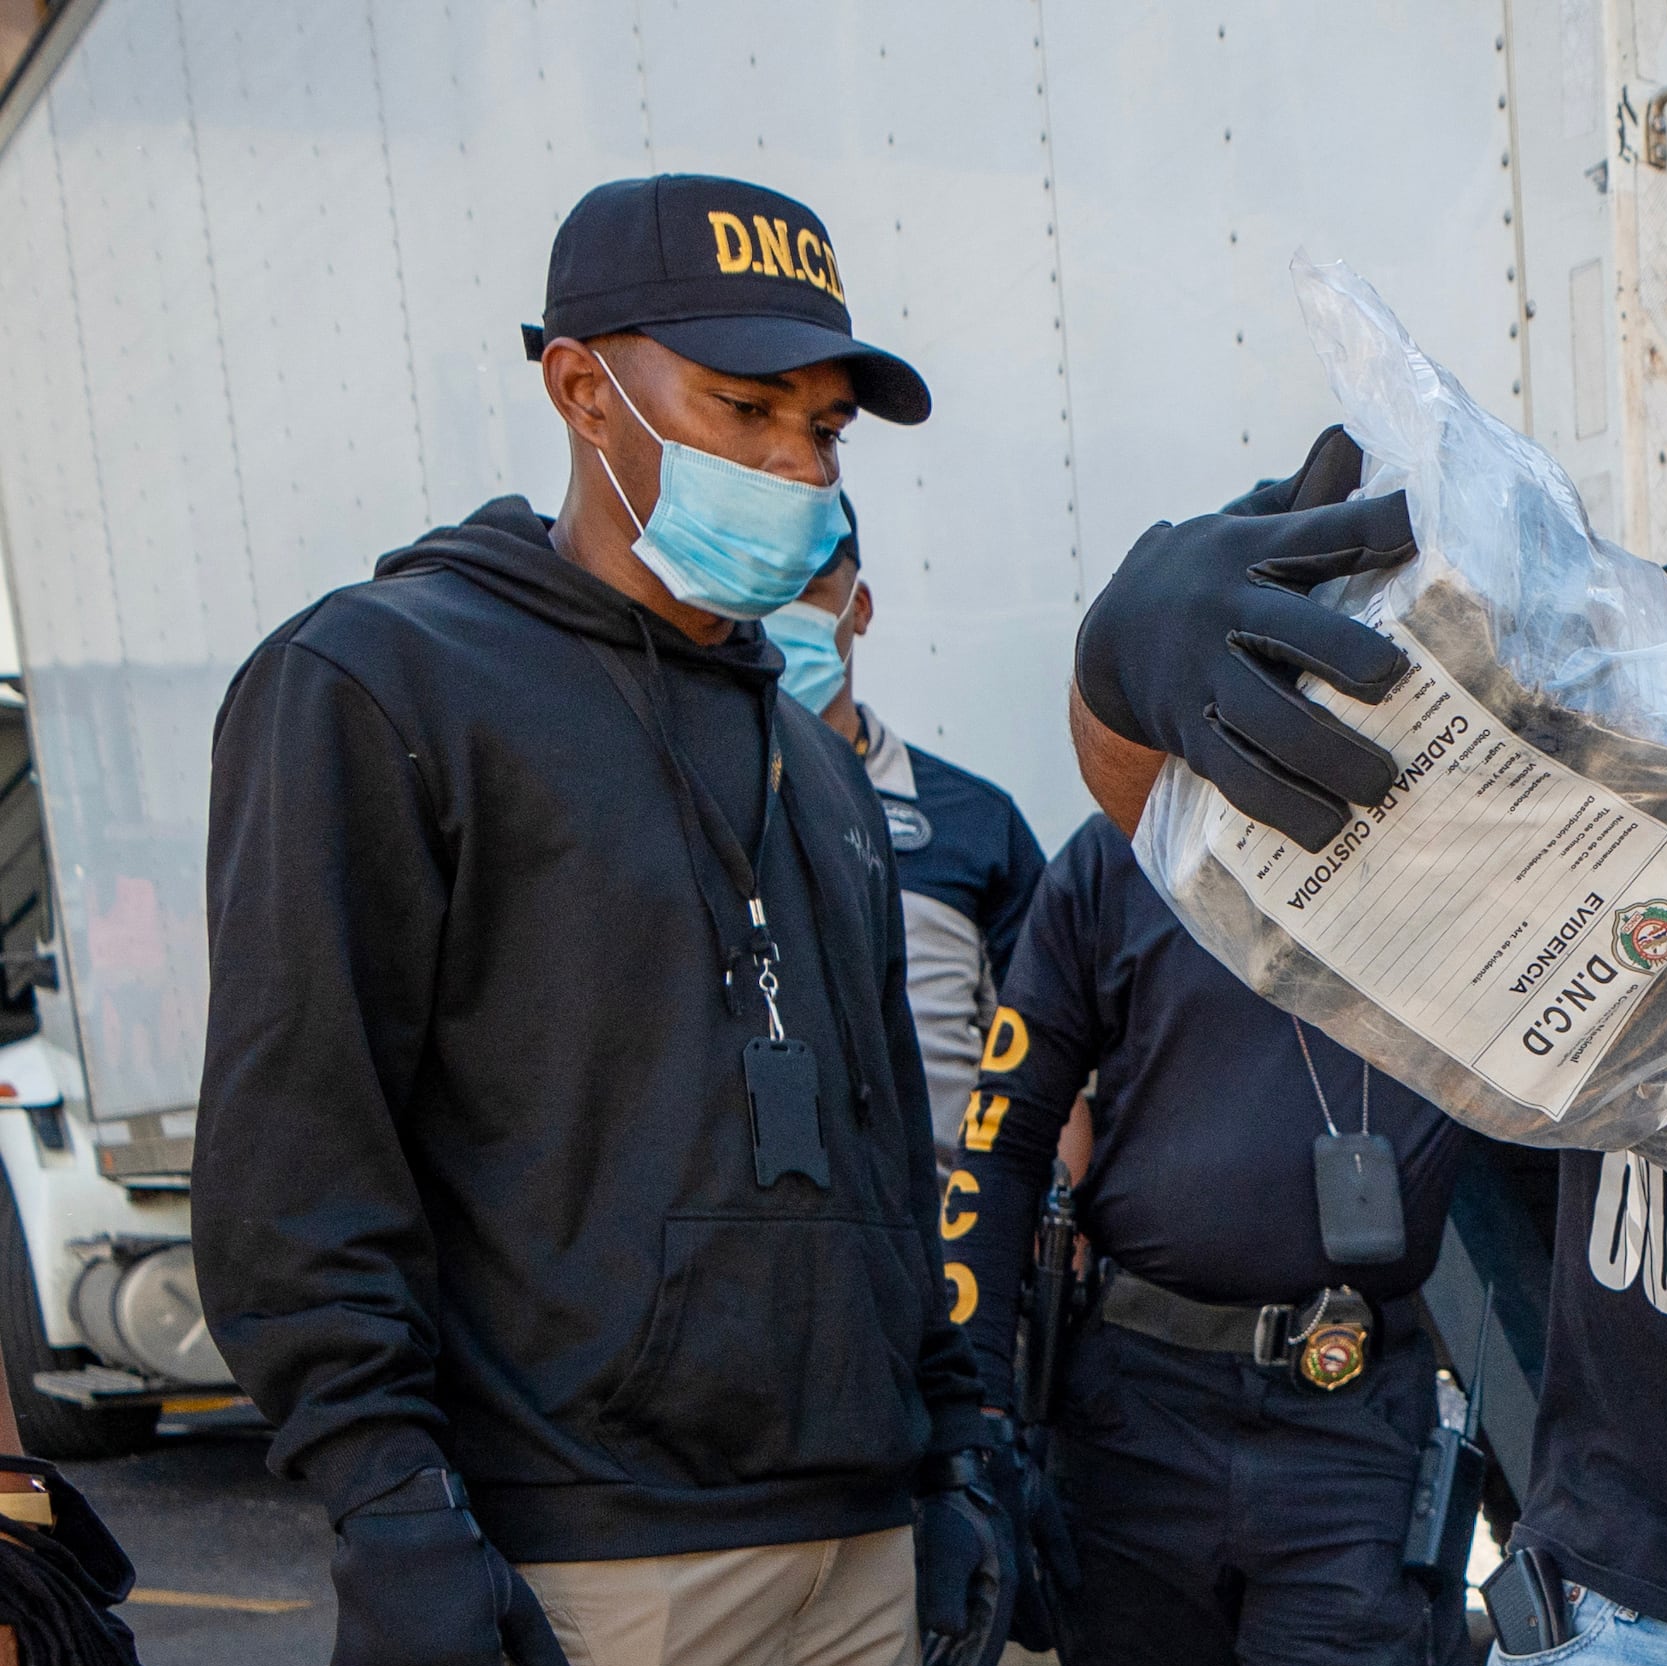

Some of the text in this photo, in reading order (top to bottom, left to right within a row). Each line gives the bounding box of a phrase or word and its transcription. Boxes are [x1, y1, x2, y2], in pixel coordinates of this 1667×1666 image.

[1380, 662, 1421, 707] Recibido de:
[1412, 678, 1434, 702] Fecha:
[1409, 691, 1449, 735] Recibido de:
[1394, 713, 1469, 795] CADENA
[1443, 727, 1489, 776] Obtenido por:
[1480, 740, 1504, 765] Lugar:
[1499, 752, 1519, 775] Fecha
[1475, 778, 1493, 798] Hora:
[1273, 846, 1285, 860] AM
[1514, 795, 1594, 884] Descripción de Evidencia:
[1559, 806, 1608, 859] Tipo de Crimen:
[1568, 813, 1623, 873] Número de Caso:
[1590, 821, 1636, 873] Departamento:
[1257, 865, 1270, 879] PM
[1289, 820, 1370, 912] CUSTODIA
[1500, 939, 1512, 951] de
[1509, 891, 1605, 995] EVIDENCIA
[1470, 950, 1502, 986] Evidencia:
[1522, 953, 1619, 1056] D.N.C.D
